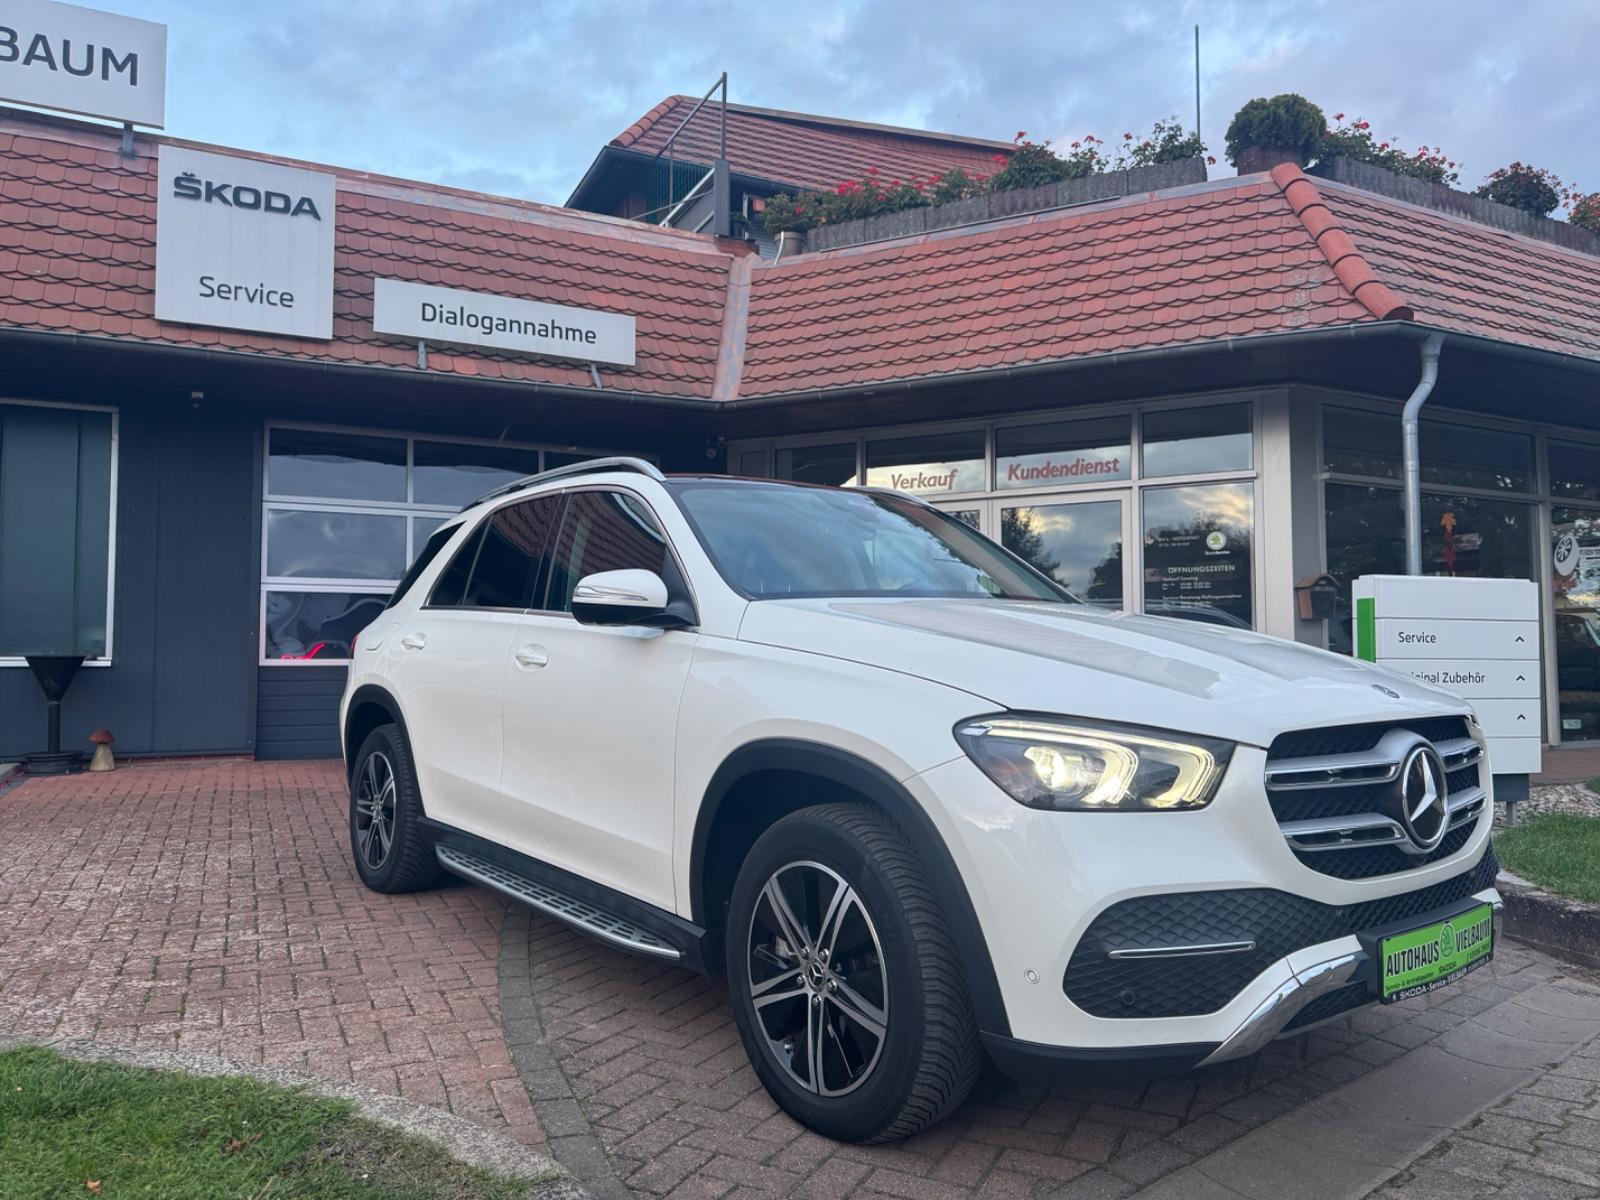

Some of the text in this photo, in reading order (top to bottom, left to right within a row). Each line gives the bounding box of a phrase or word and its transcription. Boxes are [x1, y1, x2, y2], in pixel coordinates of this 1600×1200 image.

[0, 26, 138, 86] BAUM
[173, 172, 321, 221] ŠKODA
[199, 276, 294, 308] Service
[421, 303, 597, 344] Dialogannahme
[891, 469, 959, 490] Verkauf
[1008, 458, 1120, 481] Kundendienst
[1398, 631, 1436, 643] Service
[1442, 671, 1485, 684] Zubehör
[1386, 940, 1440, 977] AUTOHAUS
